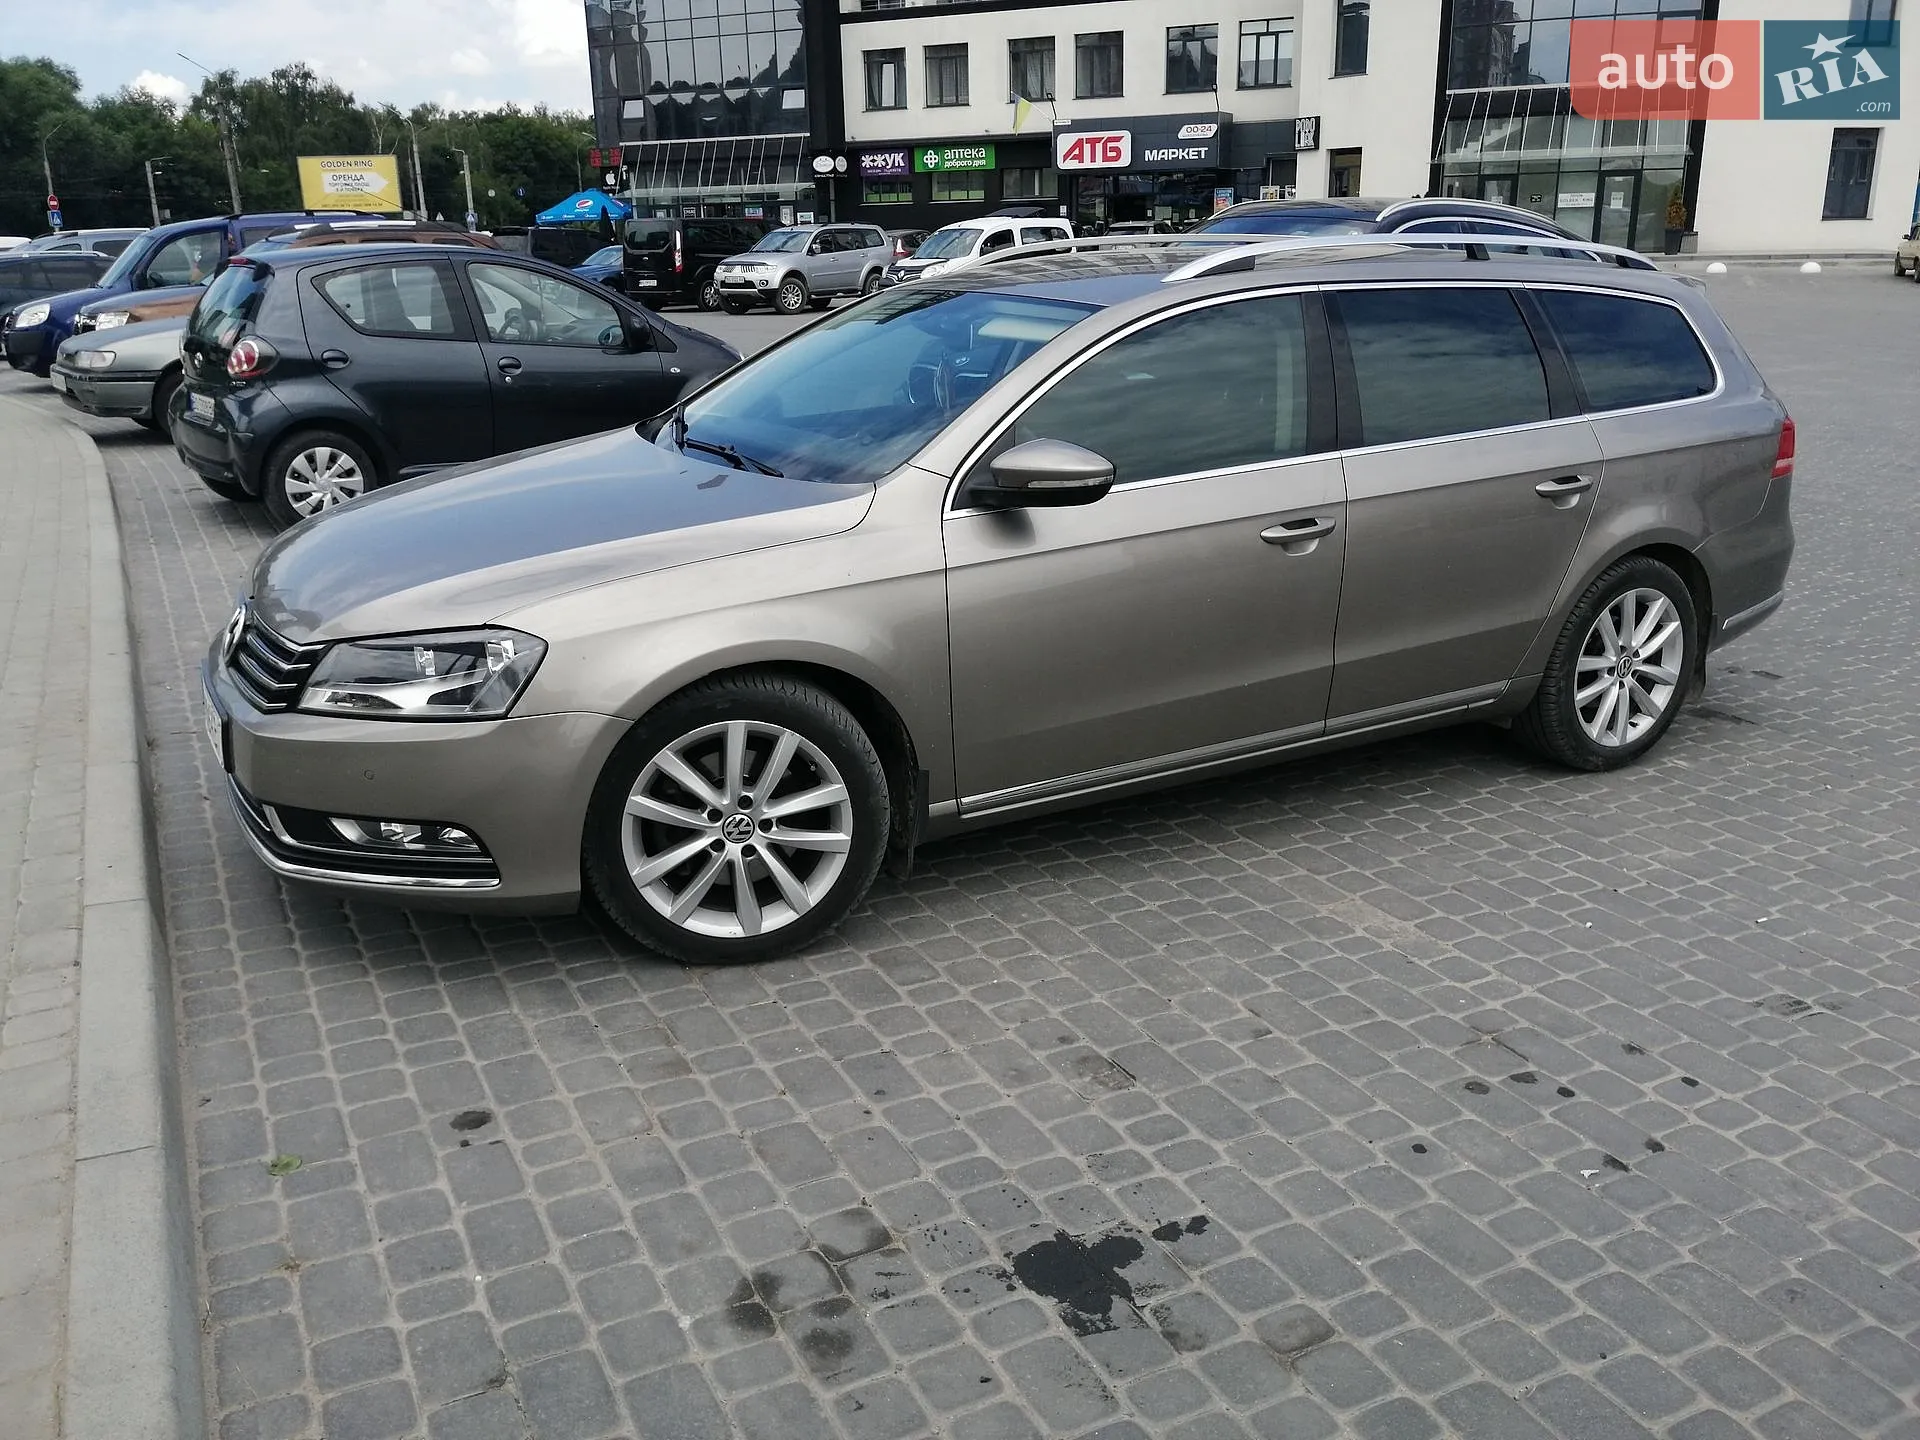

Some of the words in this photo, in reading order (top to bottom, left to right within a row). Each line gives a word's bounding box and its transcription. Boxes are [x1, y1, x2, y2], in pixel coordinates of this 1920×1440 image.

[943, 147, 986, 159] аптека
[1063, 135, 1125, 164] АТБ
[1144, 147, 1209, 162] МАРКЕТ
[320, 160, 352, 168] GOLDEN
[354, 159, 373, 167] RING
[944, 160, 972, 169] доброго
[973, 158, 986, 167] дня
